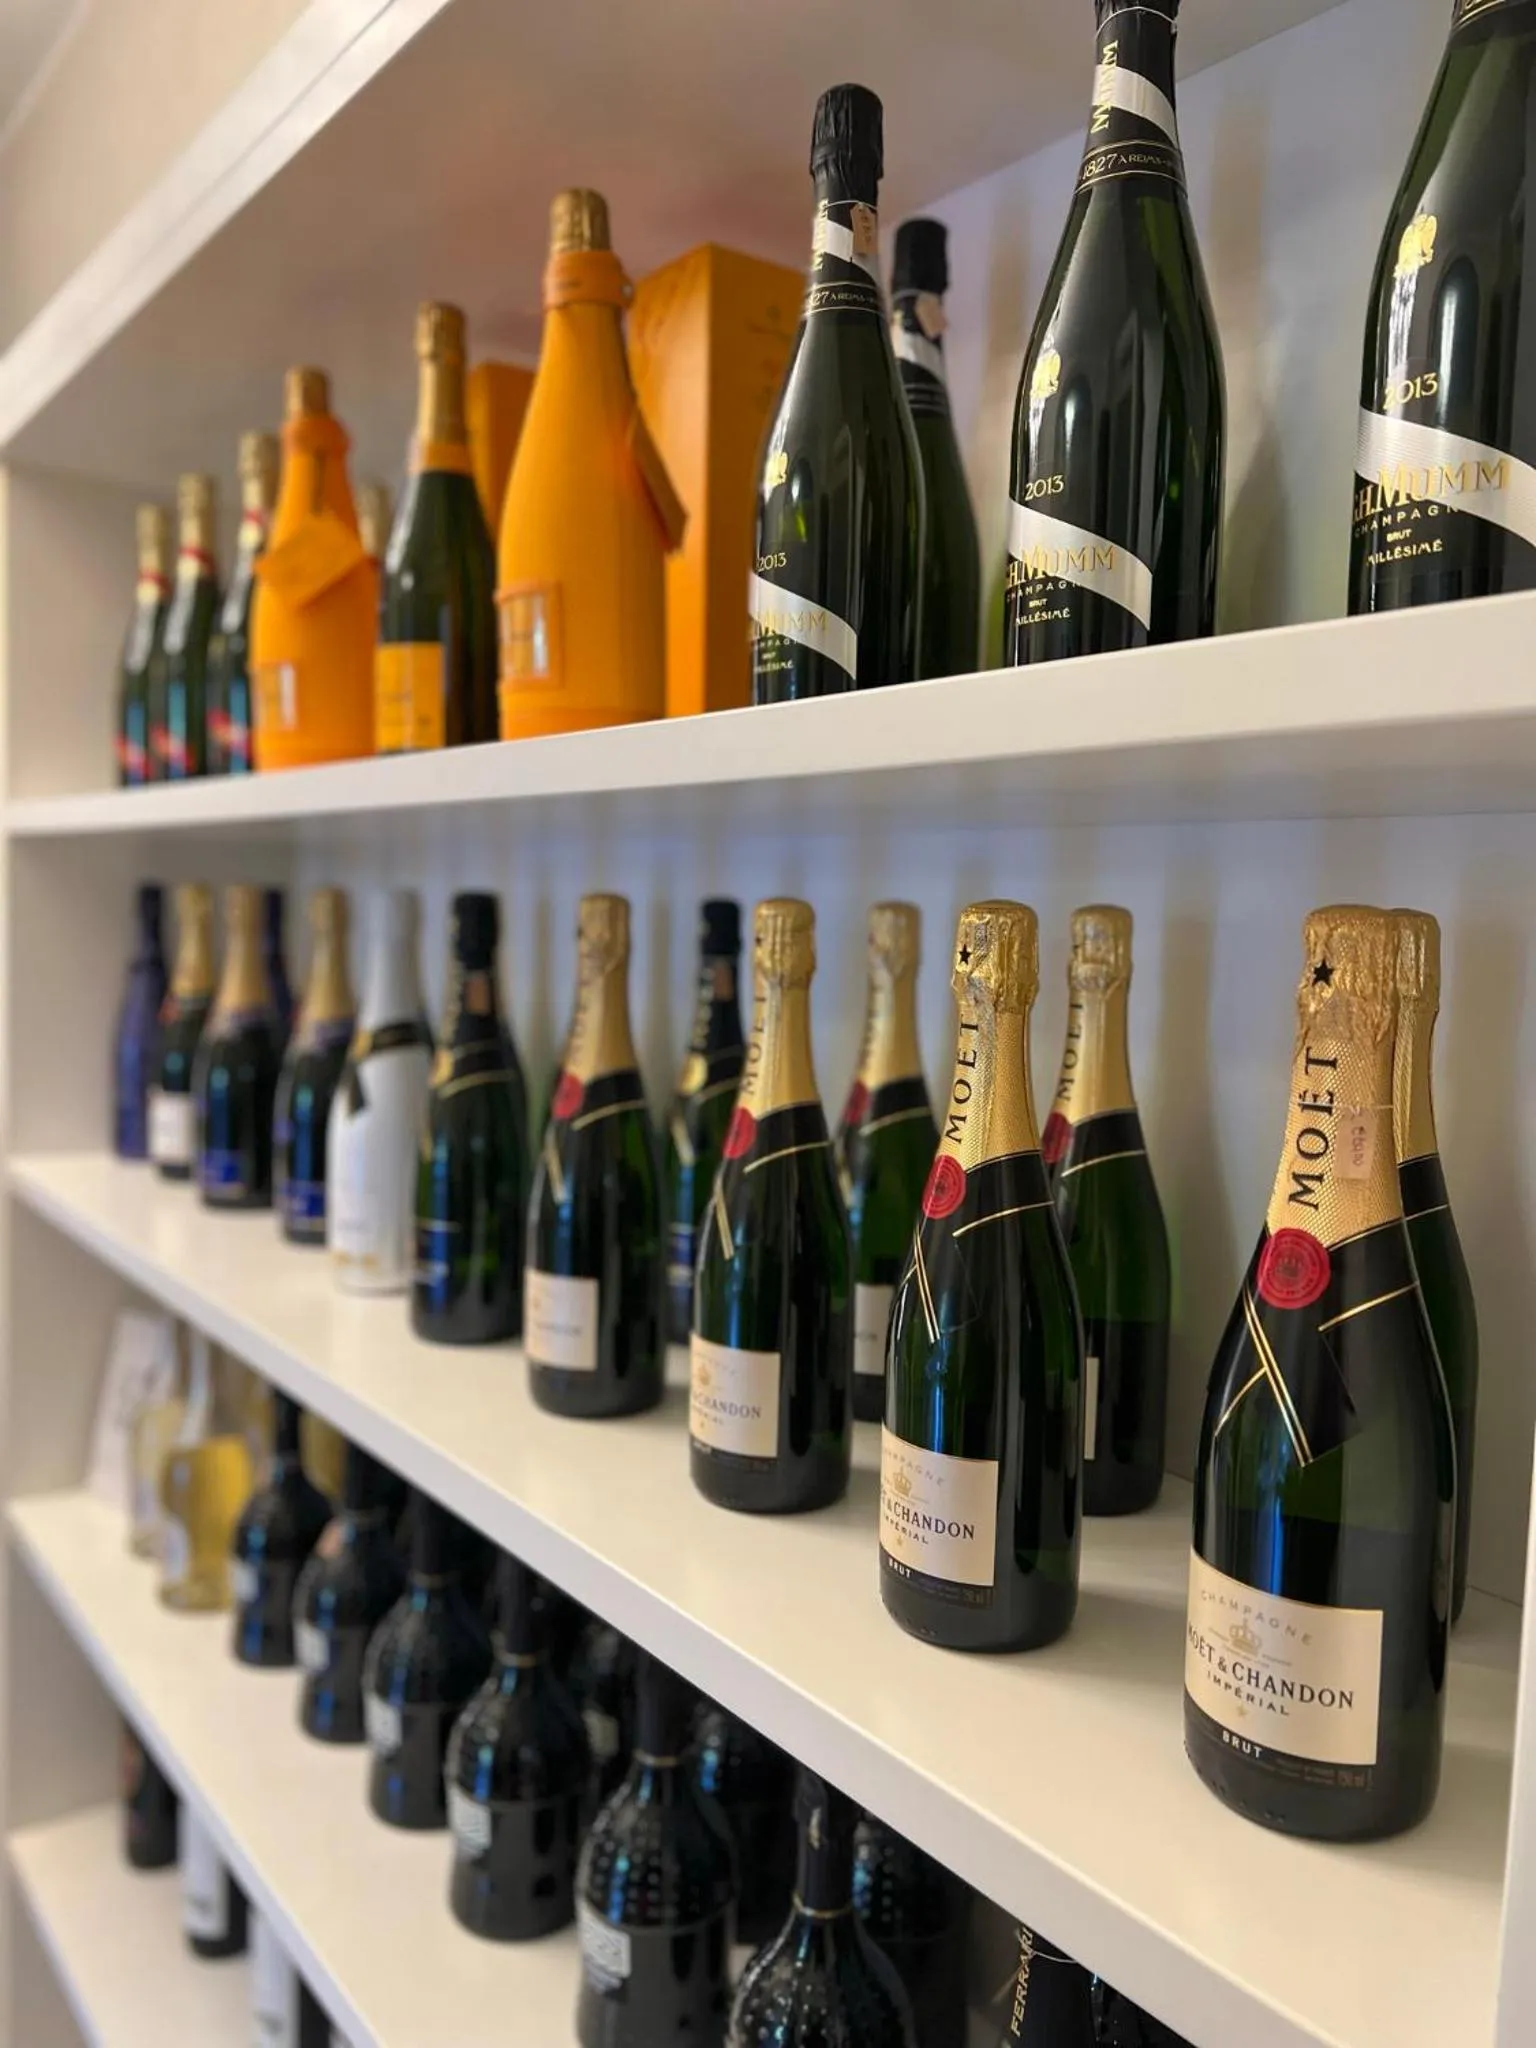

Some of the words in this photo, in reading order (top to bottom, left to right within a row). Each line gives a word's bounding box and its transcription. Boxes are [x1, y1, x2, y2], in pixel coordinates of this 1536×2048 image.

[1082, 153, 1118, 180] 1827
[1383, 371, 1439, 411] 2013
[1025, 474, 1064, 501] 2013
[1386, 528, 1412, 542] BRUT
[757, 552, 788, 573] 2013
[893, 1501, 975, 1541] CHANDON
[1201, 1589, 1314, 1646] CHAMPAGNE
[1218, 1656, 1228, 1675] &
[1232, 1661, 1355, 1711] CHANDON
[1222, 1729, 1262, 1759] BRUT
